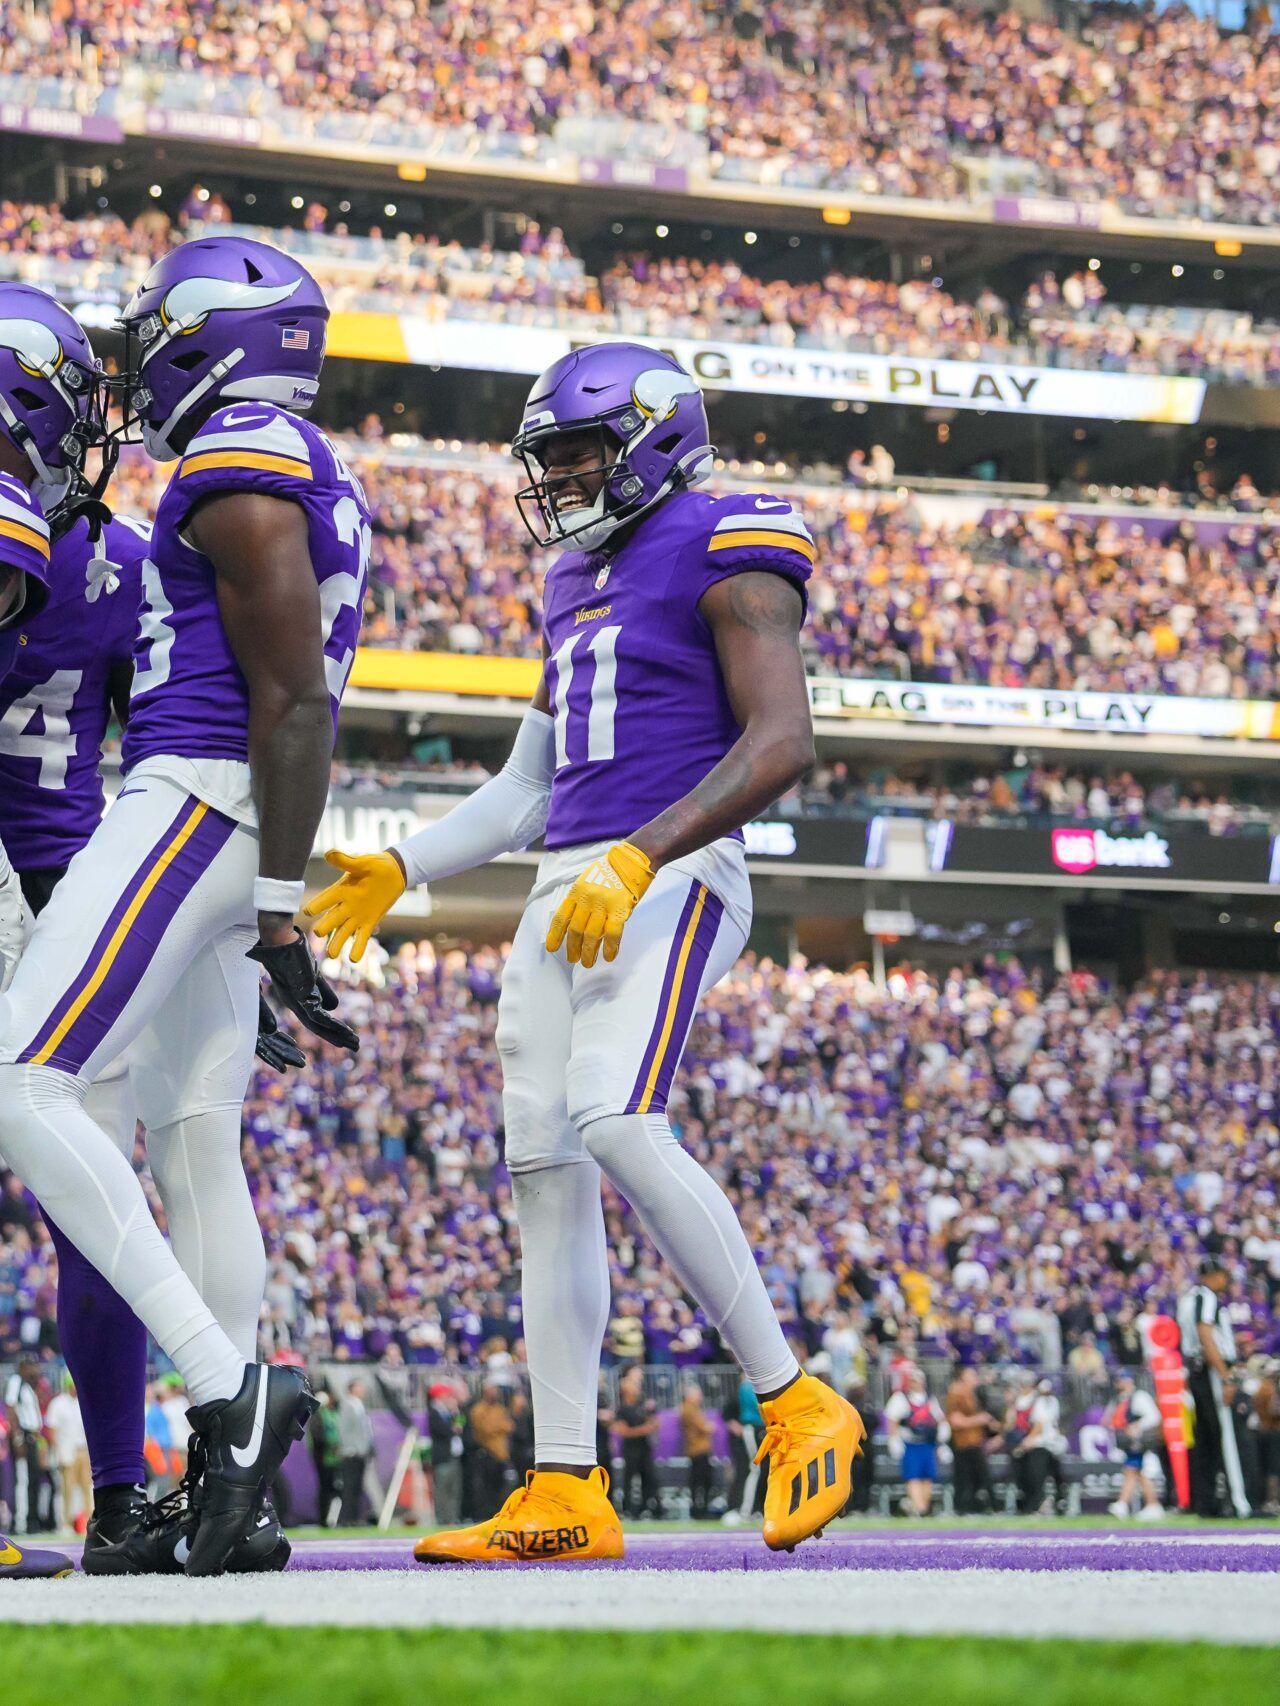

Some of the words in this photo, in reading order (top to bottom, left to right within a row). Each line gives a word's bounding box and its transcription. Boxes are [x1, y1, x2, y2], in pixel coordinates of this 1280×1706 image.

[750, 359, 797, 380] ON
[808, 363, 871, 387] THE
[888, 366, 1040, 403] PLAY
[551, 625, 623, 769] 11
[812, 686, 927, 712] FLAG
[1043, 699, 1153, 724] PLAY
[485, 1525, 589, 1553] ADIZERO
